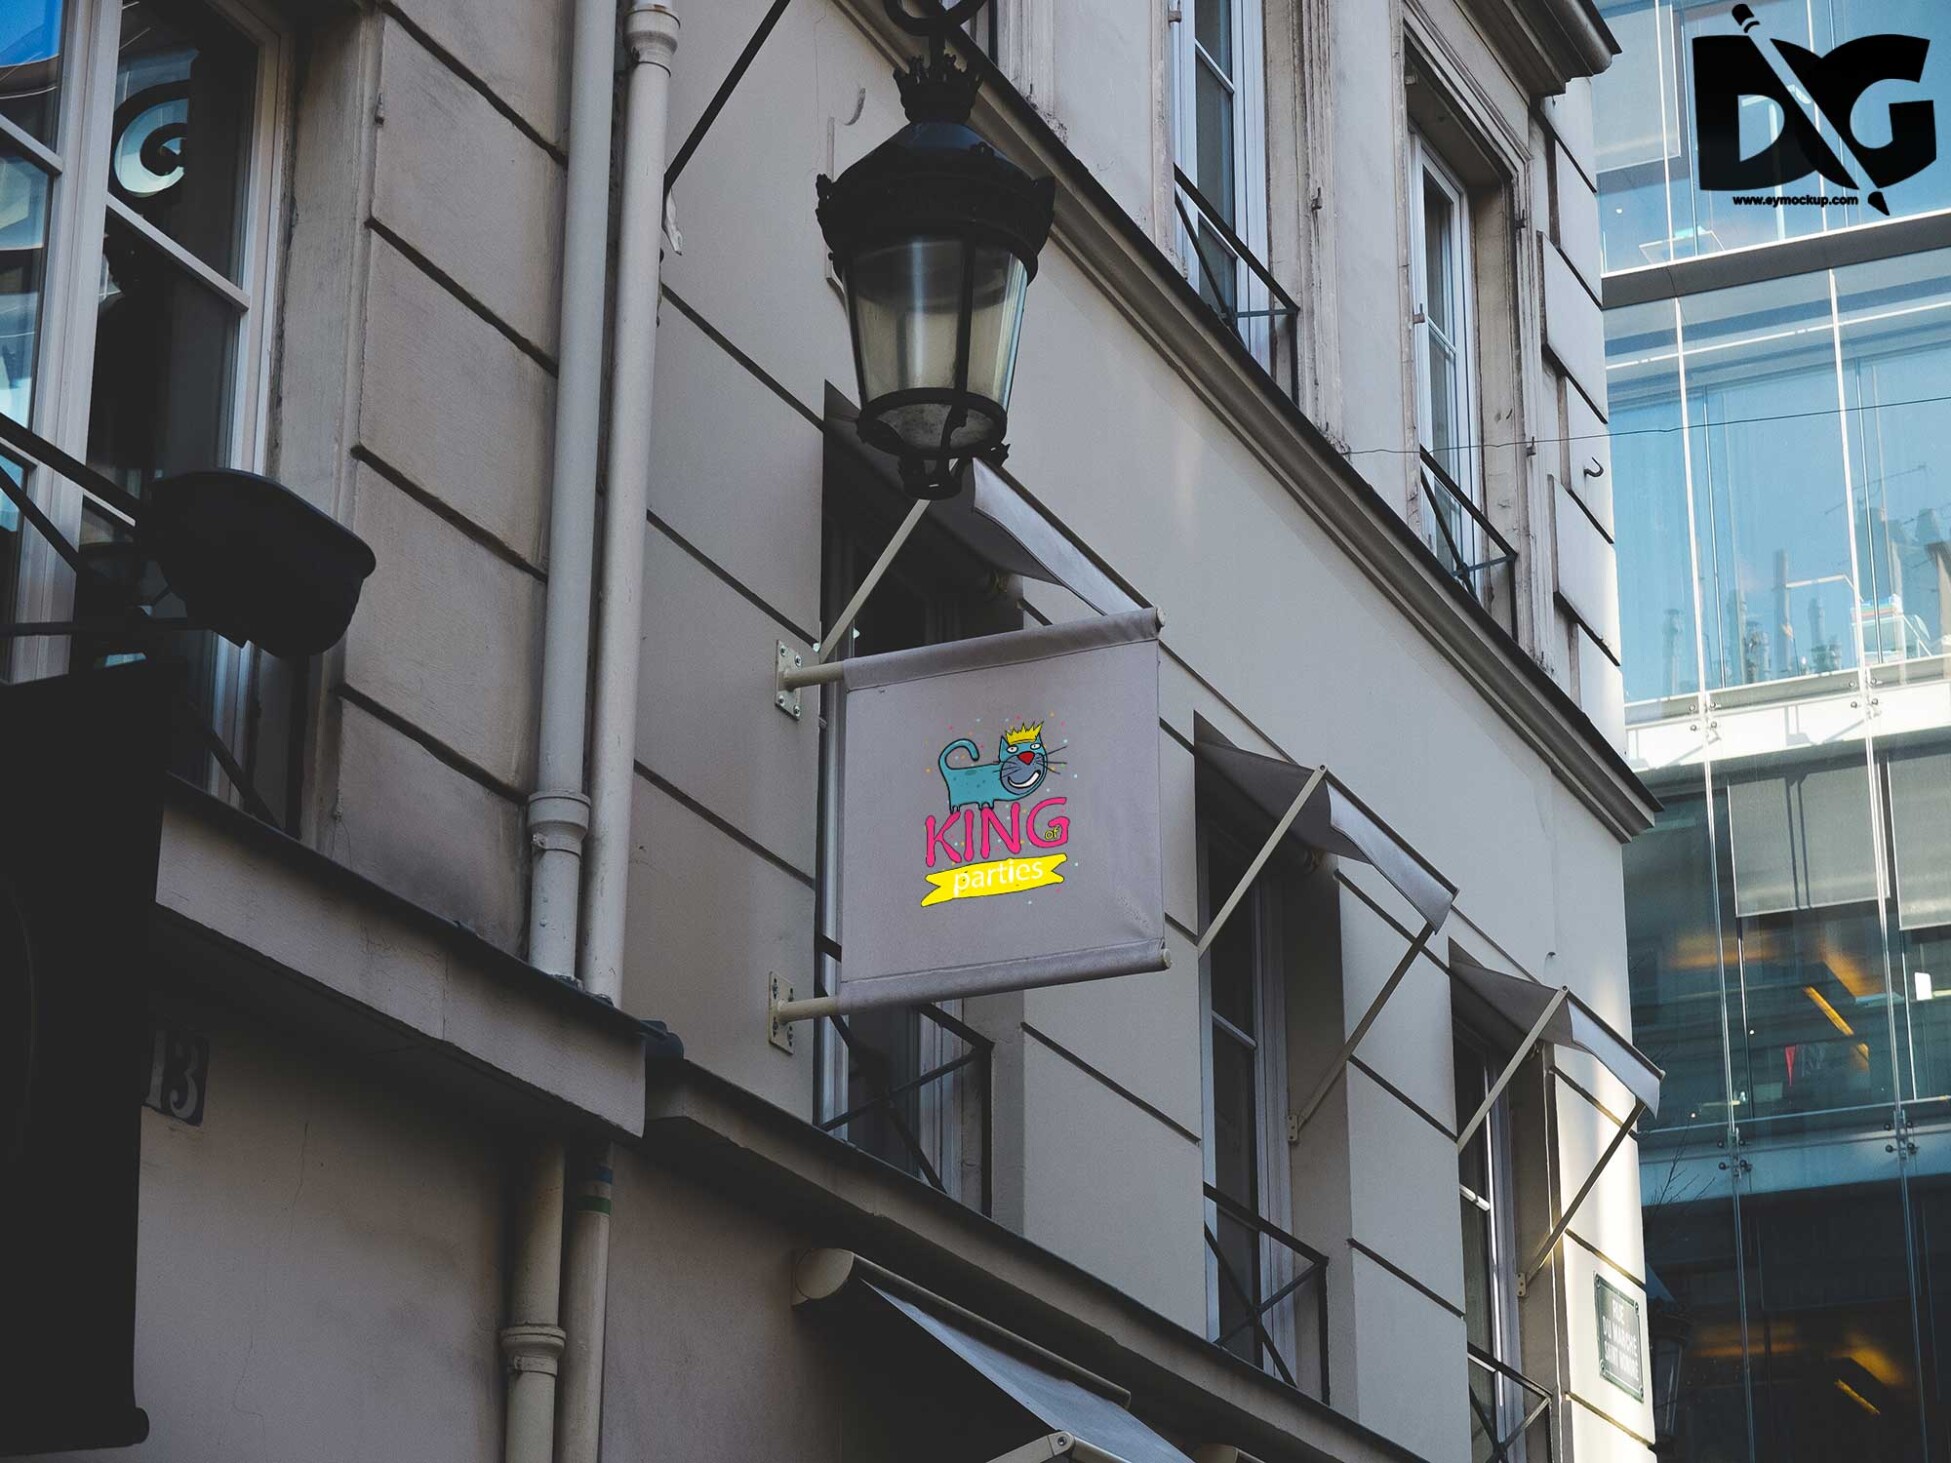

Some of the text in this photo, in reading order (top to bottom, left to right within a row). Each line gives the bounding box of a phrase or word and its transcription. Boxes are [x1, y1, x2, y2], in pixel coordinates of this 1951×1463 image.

[925, 797, 1071, 868] KING
[1044, 826, 1060, 841] of
[953, 858, 1044, 897] parties
[145, 1029, 198, 1119] 13
